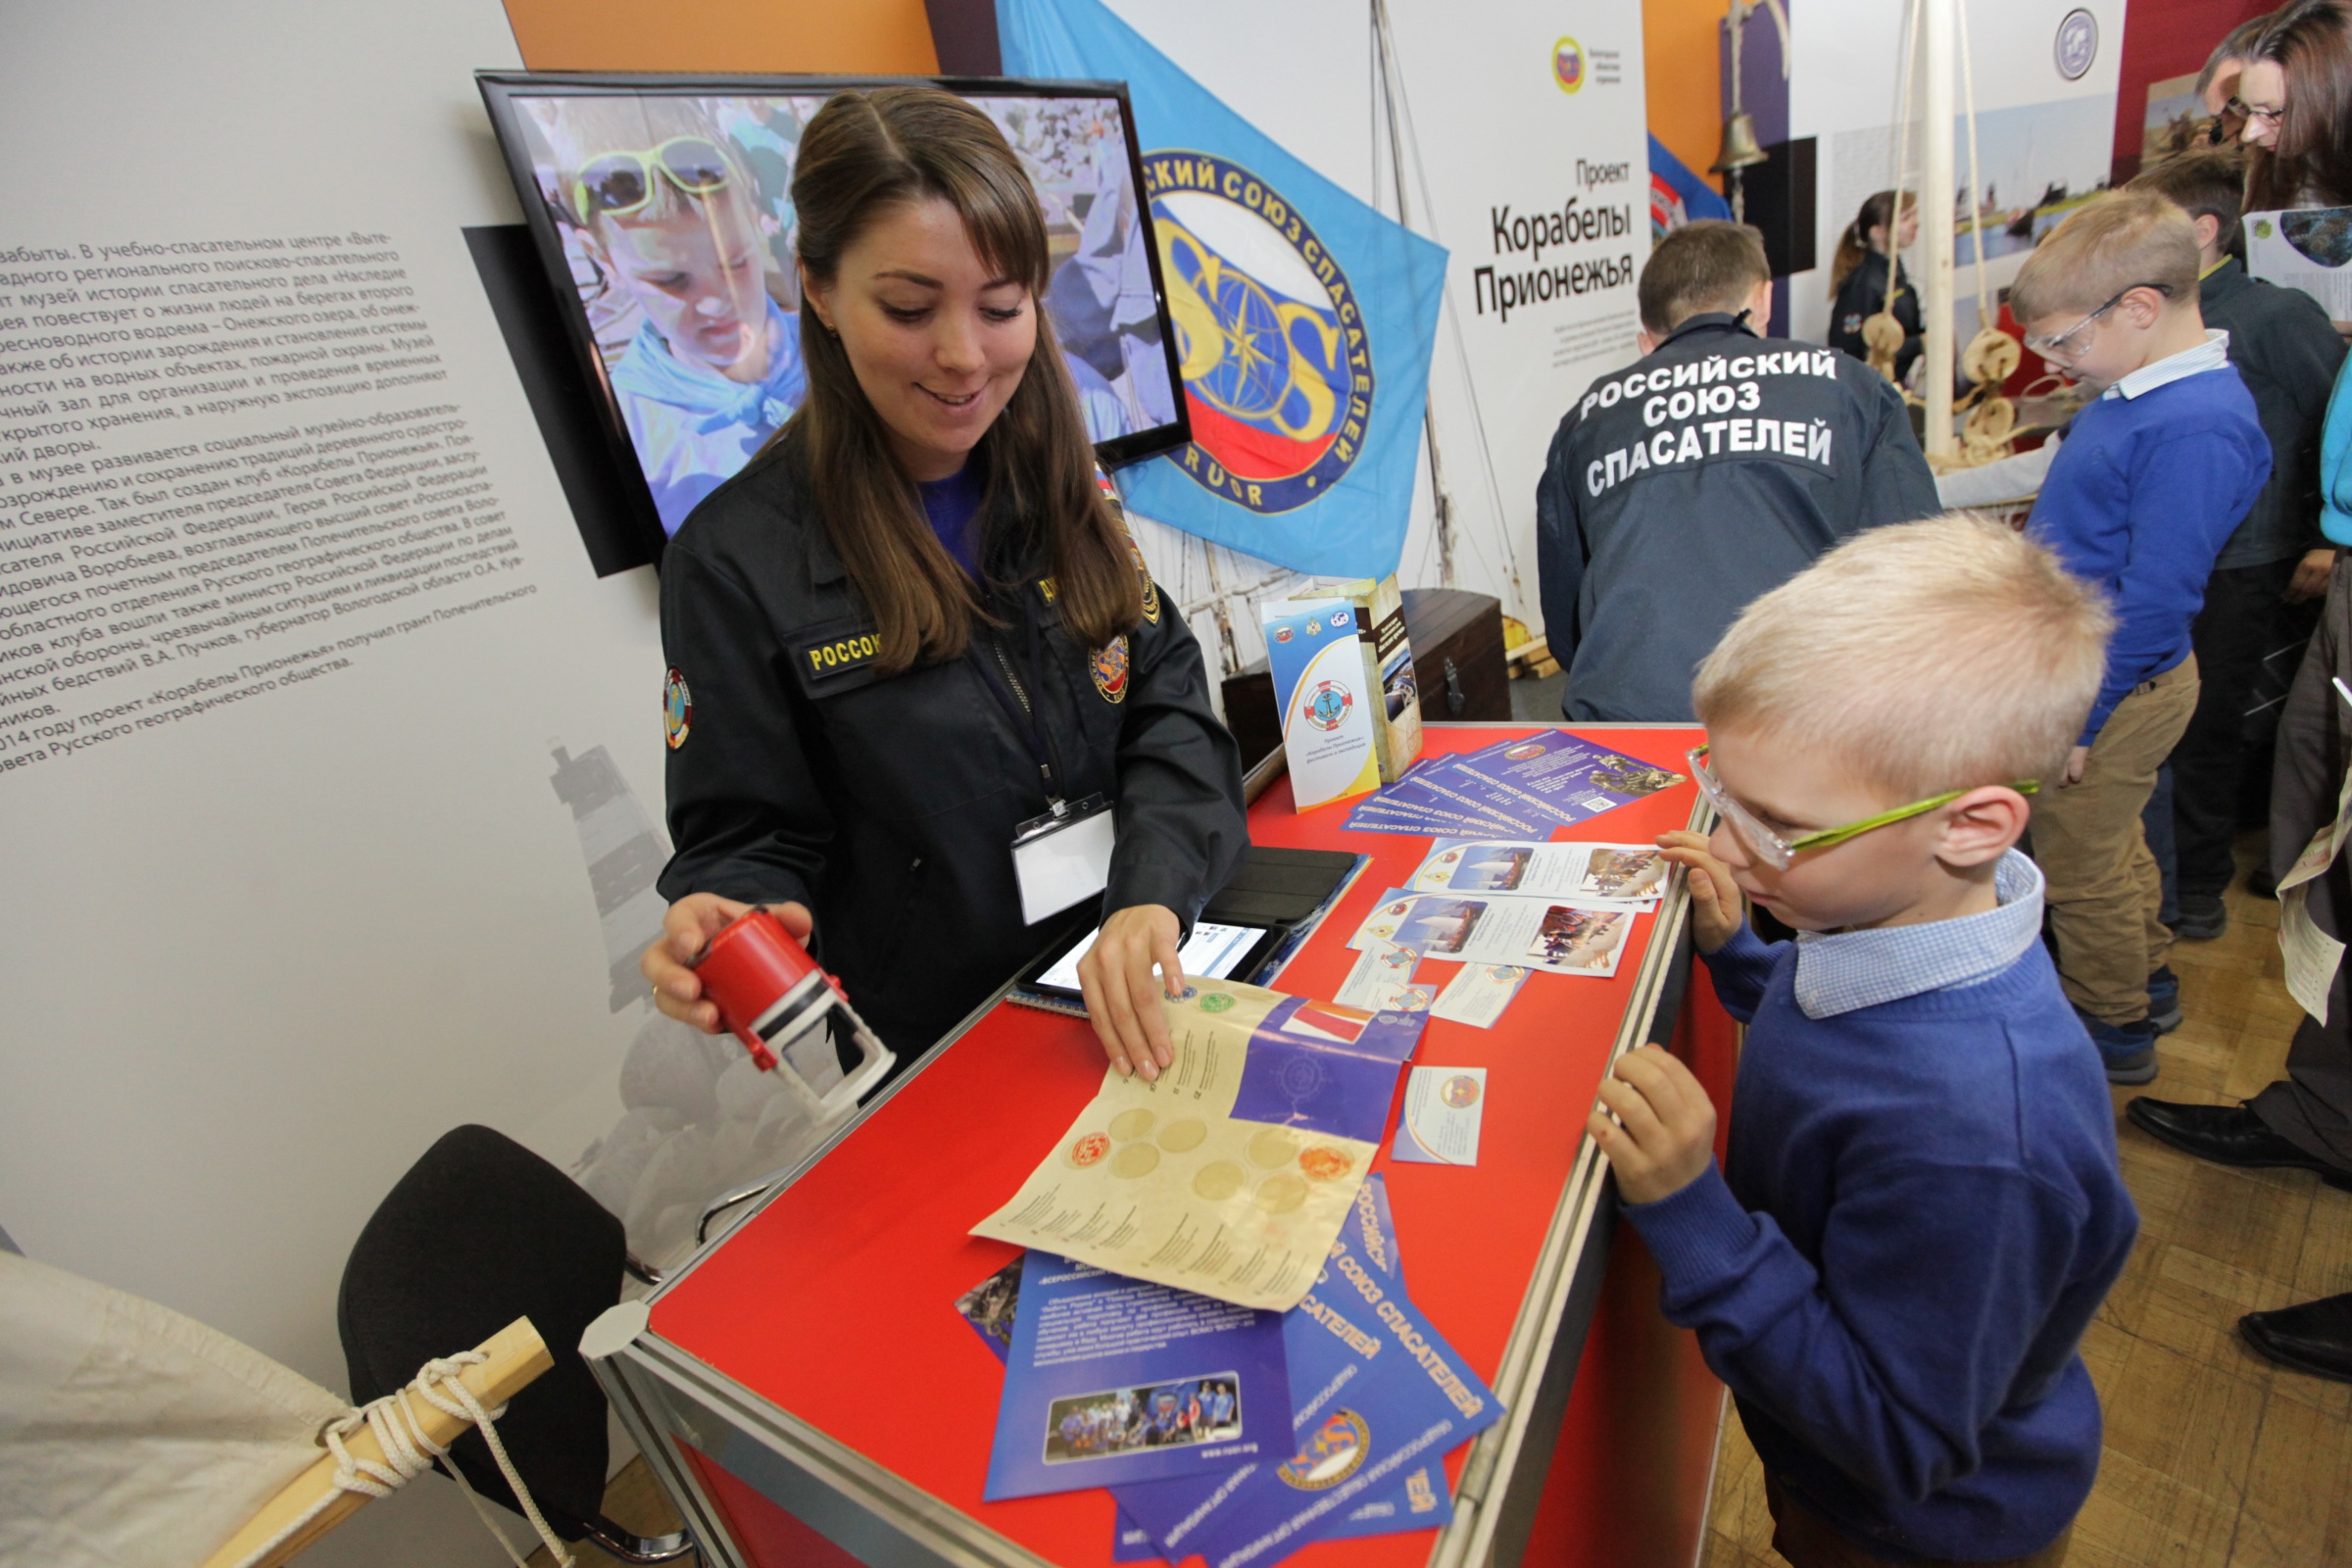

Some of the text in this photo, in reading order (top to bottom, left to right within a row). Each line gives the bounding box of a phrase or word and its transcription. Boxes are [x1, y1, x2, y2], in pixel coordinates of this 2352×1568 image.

[1576, 159, 1631, 190] Проект
[99, 238, 284, 261] учебно-спасательном
[288, 236, 342, 249] центре
[1492, 196, 1632, 261] Корабелы
[21, 288, 80, 309] музей
[86, 285, 163, 301] истории
[169, 277, 288, 295] спасательного
[292, 274, 327, 287] дела
[74, 262, 210, 284] регионального
[1474, 254, 1635, 322] Прионежья
[33, 308, 139, 327] повествует
[159, 302, 214, 316] жизни
[219, 294, 270, 311] людей
[297, 291, 355, 306] берегах
[133, 322, 209, 339] водоема
[222, 314, 311, 330] Онежского
[1222, 171, 1302, 243] СОЮЗ
[1303, 243, 1372, 464] СПАСАТЕЛЕЙ
[77, 348, 155, 367] истории
[157, 337, 260, 359] зарождения
[274, 326, 368, 345] становления
[92, 368, 160, 386] водных
[251, 346, 329, 367] пожарной
[59, 398, 90, 412] зал
[97, 392, 131, 409] для
[137, 378, 249, 404] организации
[270, 364, 361, 386] проведения
[198, 393, 280, 415] наружную
[284, 380, 372, 402] экспозицию
[1579, 349, 1837, 421] РОССИЙСКИЙ
[1642, 381, 1761, 427] СОЮЗ
[29, 425, 300, 483] музее развивается социальный
[135, 458, 239, 484] сохранению
[241, 442, 315, 467] традиций
[1587, 416, 1833, 497] СПАСАТЕЛЕЙ
[98, 472, 363, 533] заместителя председателя Совета
[101, 497, 129, 512] Так
[133, 490, 169, 506] был
[172, 478, 230, 498] создан
[235, 468, 271, 486] клуб
[72, 525, 176, 560] Российской
[284, 498, 327, 514] Героя
[184, 519, 314, 556] возглавляющего
[316, 505, 371, 527] высший
[86, 569, 174, 599] почетным
[178, 542, 298, 578] председателем
[110, 584, 200, 613] отделения
[204, 566, 274, 593] Русского
[49, 626, 103, 650] клуба
[110, 612, 167, 635] вошли
[172, 598, 221, 619] также
[225, 581, 292, 606] министр
[151, 605, 273, 646] чрезвычайным
[274, 584, 353, 612] ситуациям
[53, 657, 137, 692] бедствий
[245, 608, 331, 640] губернатор
[33, 718, 76, 740] году
[79, 699, 145, 727] проект
[49, 722, 133, 757] Русского
[136, 679, 276, 730] географического
[1409, 775, 1458, 799] СПАСАТЕЛЕЙ
[1452, 762, 1499, 786] СПАСАТЕЛЕЙ
[1497, 782, 1523, 796] СОЮЗ
[1373, 796, 1464, 820] СОЮЗ СПАСАТЕЛЕЙ
[1455, 795, 1482, 808] СОЮЗ
[1478, 805, 1539, 834] РОССИЙСКИЙ
[1518, 792, 1577, 823] РОССИЙСКИЙ
[1348, 821, 1421, 833] СПАСАТЕЛЕЙ
[1423, 825, 1458, 834] СОЮЗ
[1337, 1255, 1486, 1420] СОЮЗ СПАСАТЕЛЕЙ
